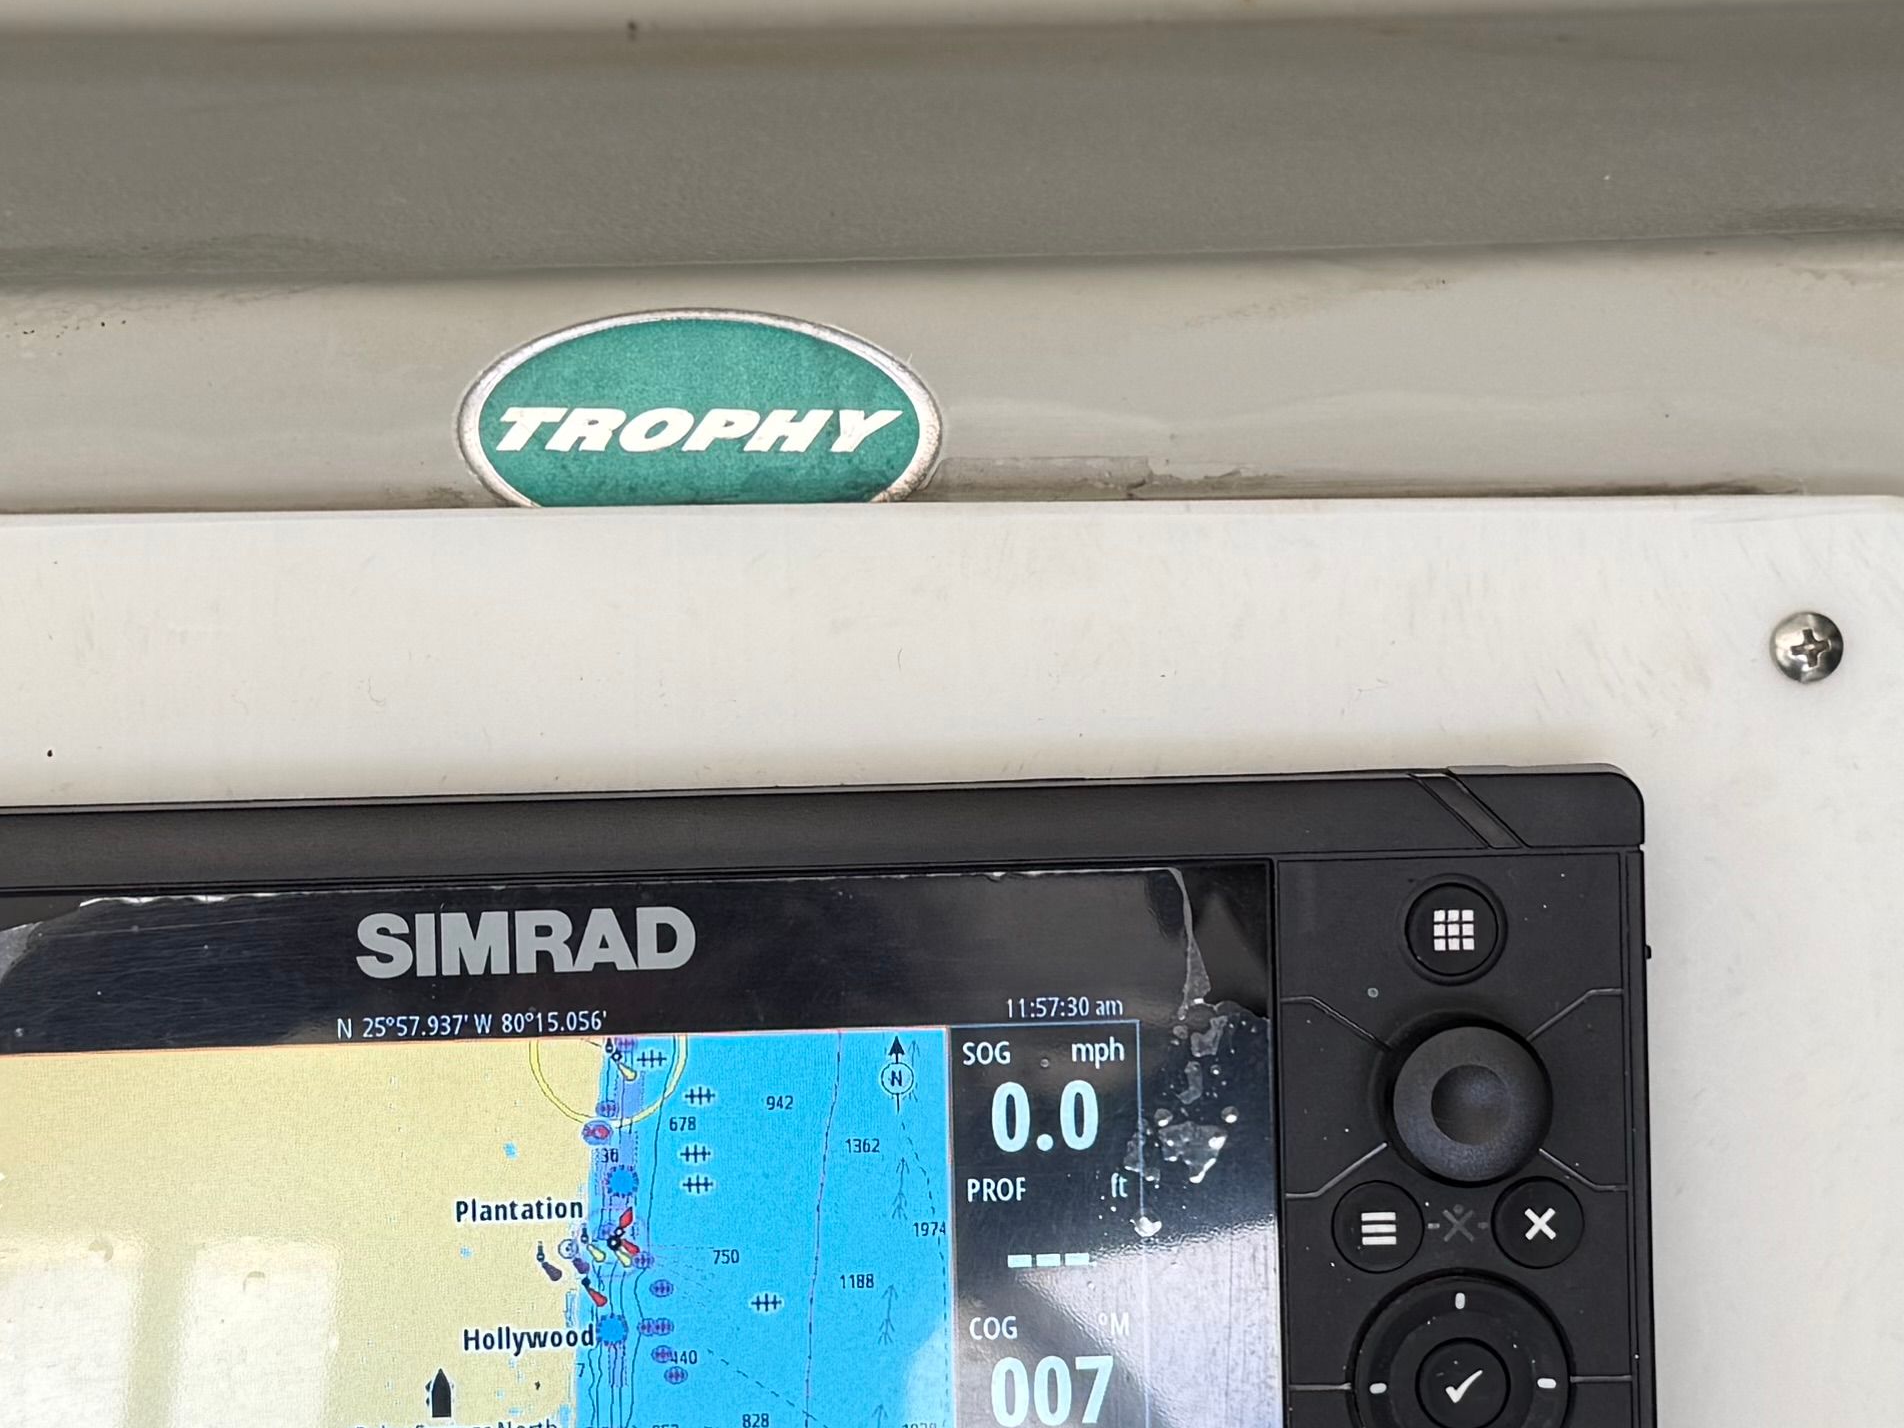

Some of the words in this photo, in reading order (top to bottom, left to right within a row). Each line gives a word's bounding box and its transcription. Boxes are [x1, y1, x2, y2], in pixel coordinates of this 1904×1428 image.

[496, 406, 903, 453] TROPHY
[356, 906, 696, 979] SIMRAD
[1006, 997, 1089, 1018] 11:57:30
[1096, 999, 1123, 1016] am
[337, 1018, 352, 1039] N
[474, 1014, 492, 1034] W
[962, 1041, 1011, 1066] SOG
[1071, 1036, 1125, 1069] mph
[766, 1095, 794, 1110] 942
[669, 1116, 696, 1132] 678
[991, 1079, 1099, 1153] 0.0
[845, 1137, 880, 1155] 1362
[967, 1177, 1027, 1202] PROF
[1111, 1172, 1128, 1198] ft
[455, 1198, 583, 1223] Plantation
[912, 1220, 946, 1237] 1974
[712, 1249, 740, 1265] 750
[463, 1324, 595, 1356] Hollywood
[969, 1316, 1018, 1341] COG
[990, 1355, 1115, 1428] 007
[742, 1414, 769, 1428] 828
